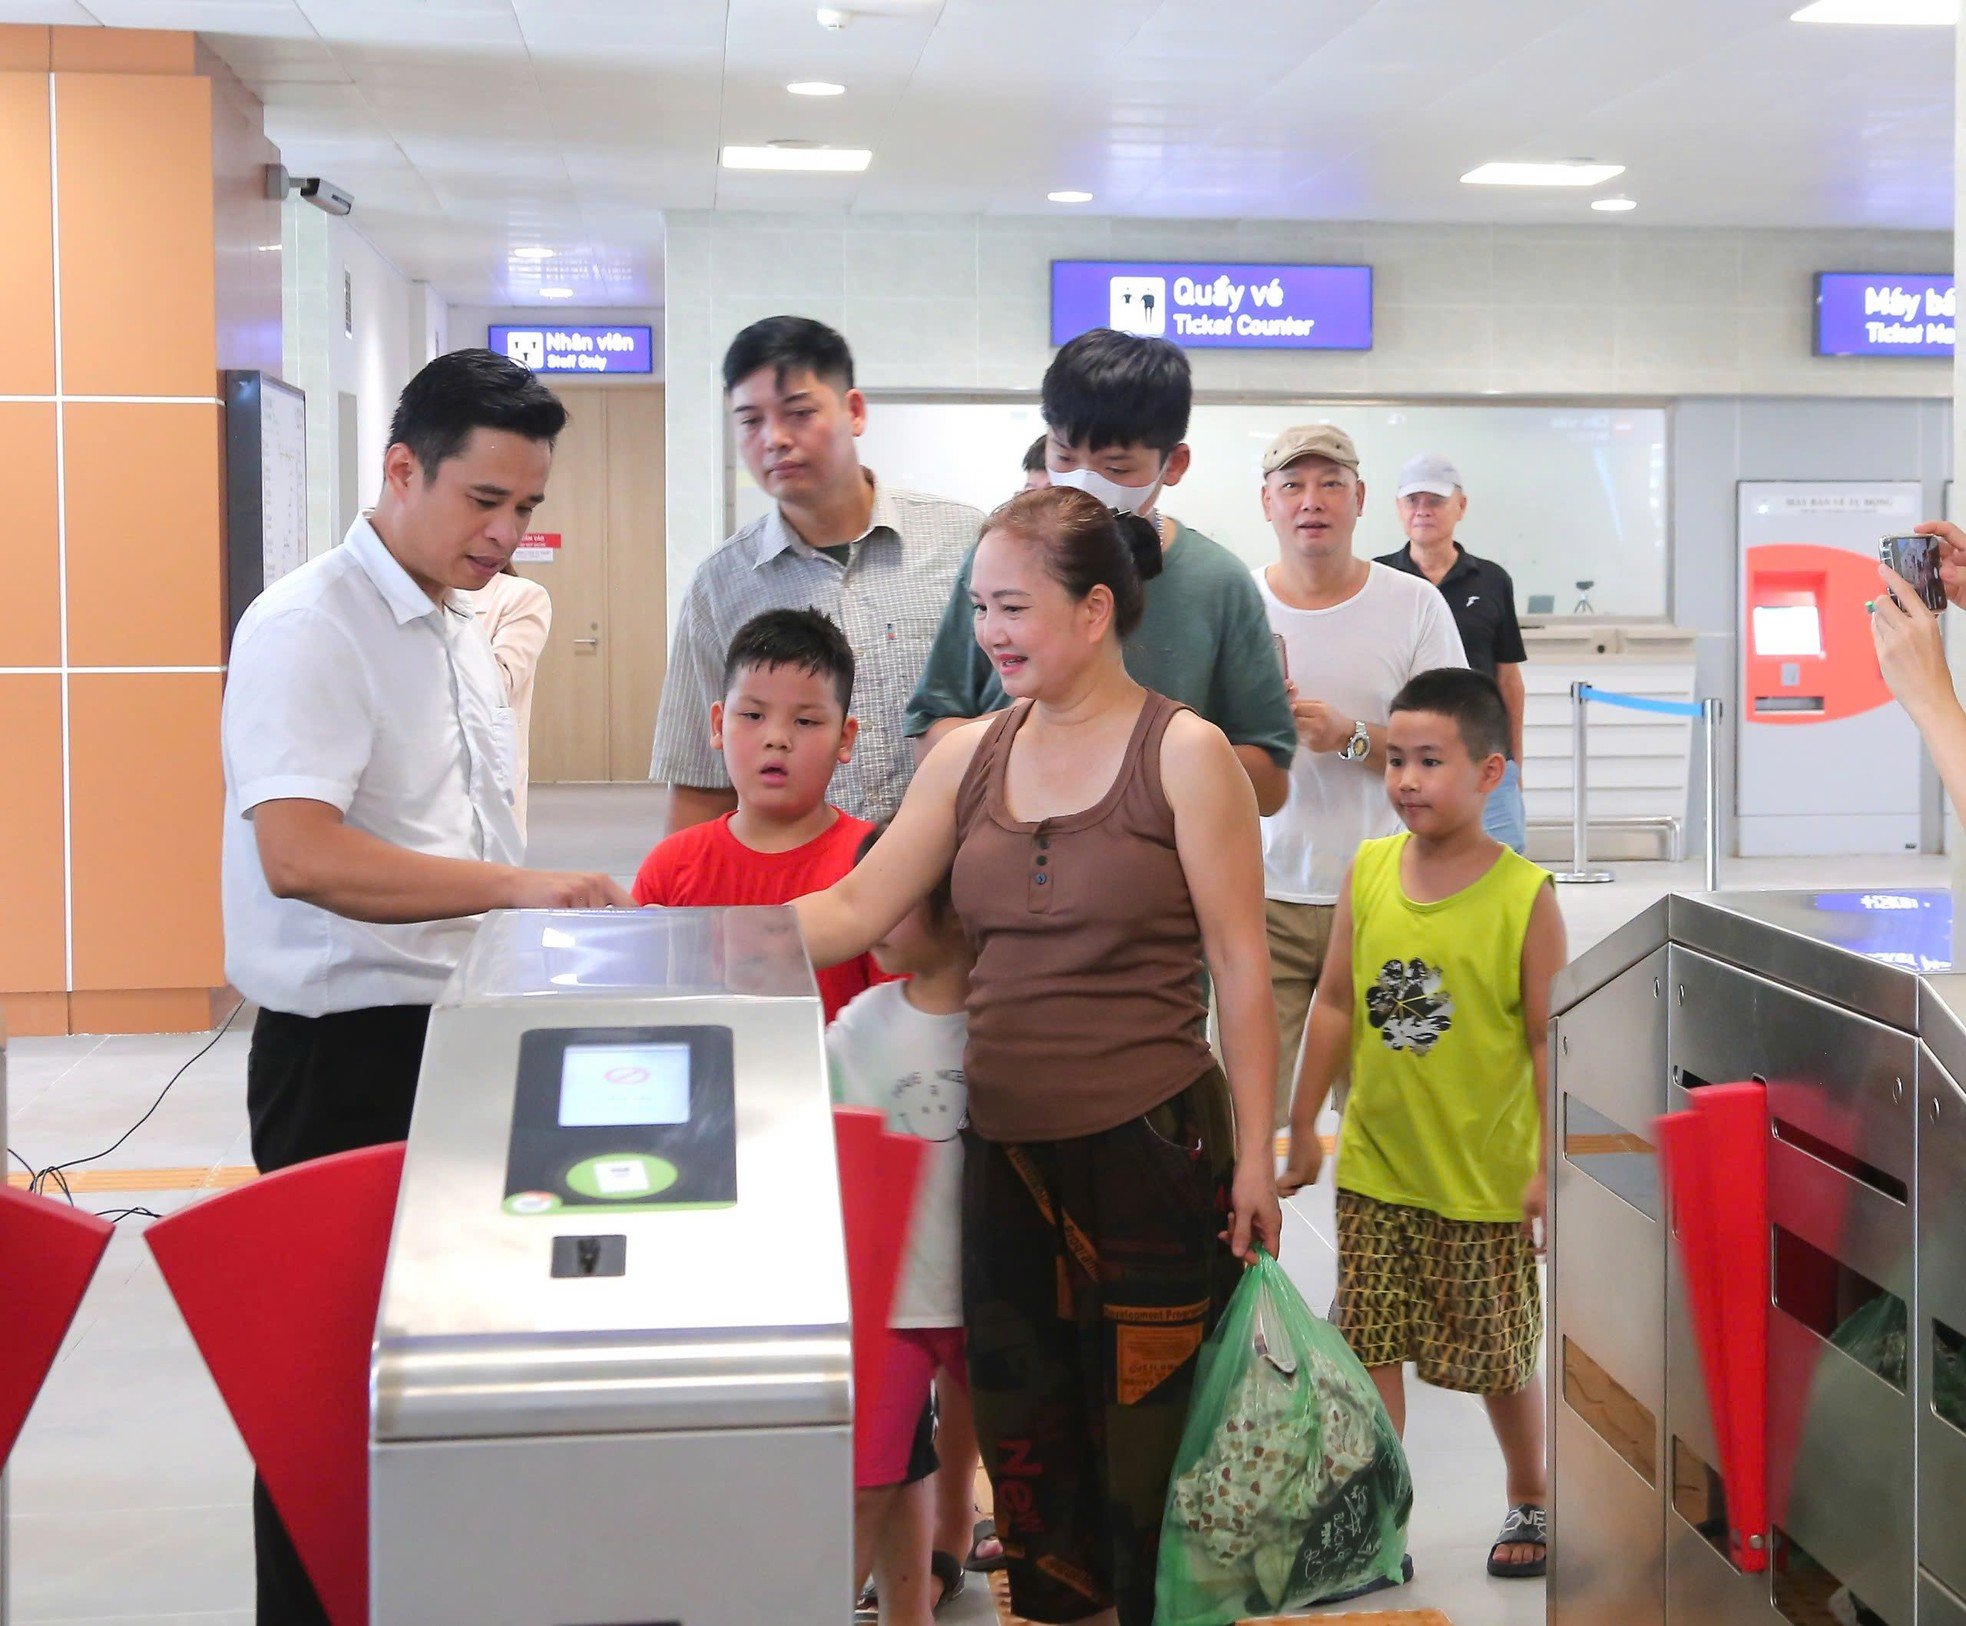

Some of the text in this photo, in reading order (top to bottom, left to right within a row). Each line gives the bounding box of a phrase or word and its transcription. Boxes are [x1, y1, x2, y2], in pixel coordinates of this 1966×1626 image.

[1865, 287, 1921, 322] Máy
[1173, 313, 1314, 336] Ticket Counter
[1866, 321, 1924, 343] Ticket
[546, 331, 634, 351] Nhân viên
[547, 353, 607, 371] Staff Only
